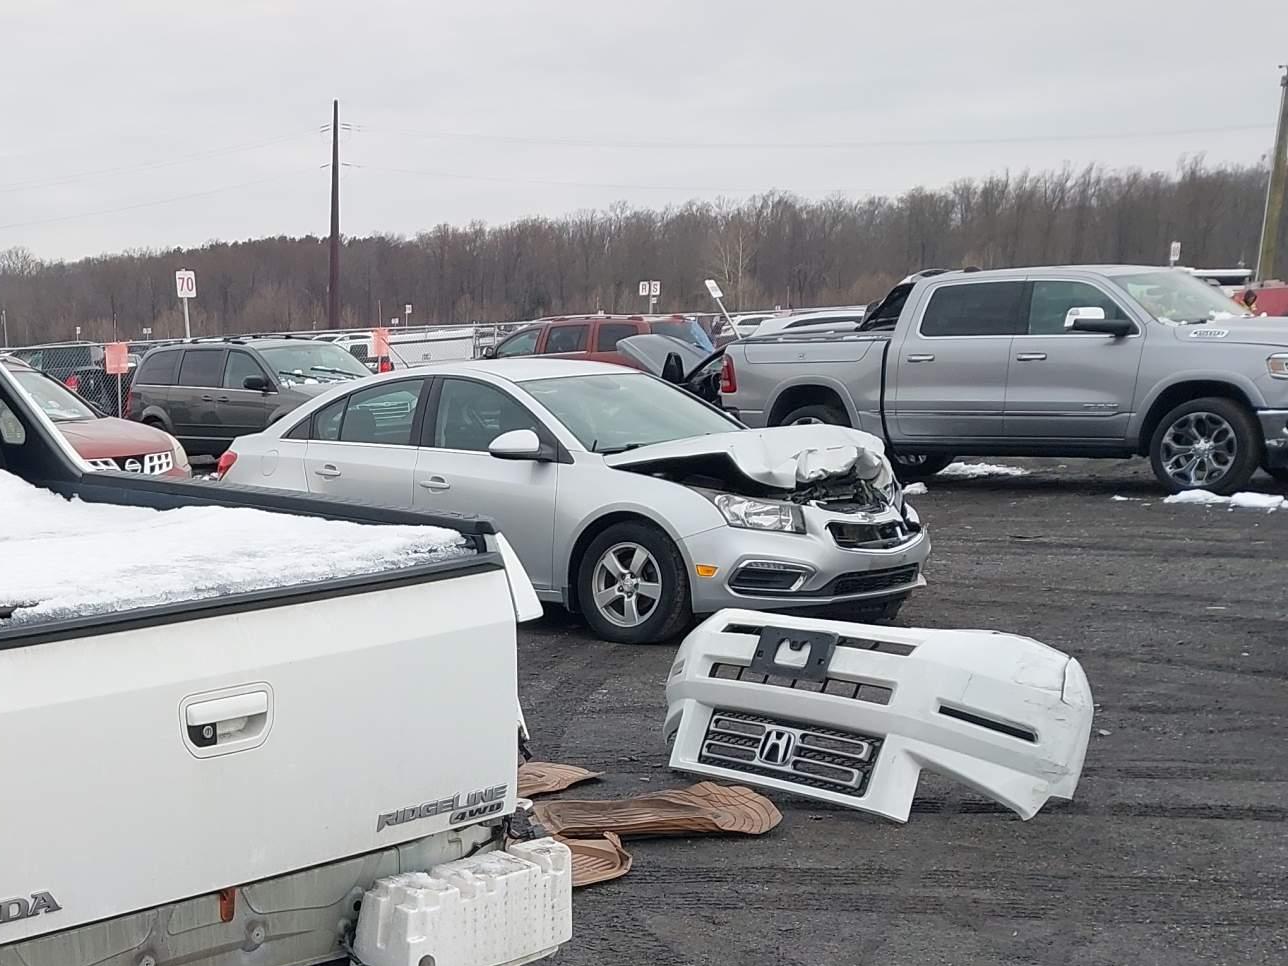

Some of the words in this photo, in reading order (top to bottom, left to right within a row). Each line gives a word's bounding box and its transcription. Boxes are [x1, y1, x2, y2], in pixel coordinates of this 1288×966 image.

[177, 276, 194, 292] 70
[376, 784, 508, 832] RIDGELINE
[451, 801, 503, 823] 4WD
